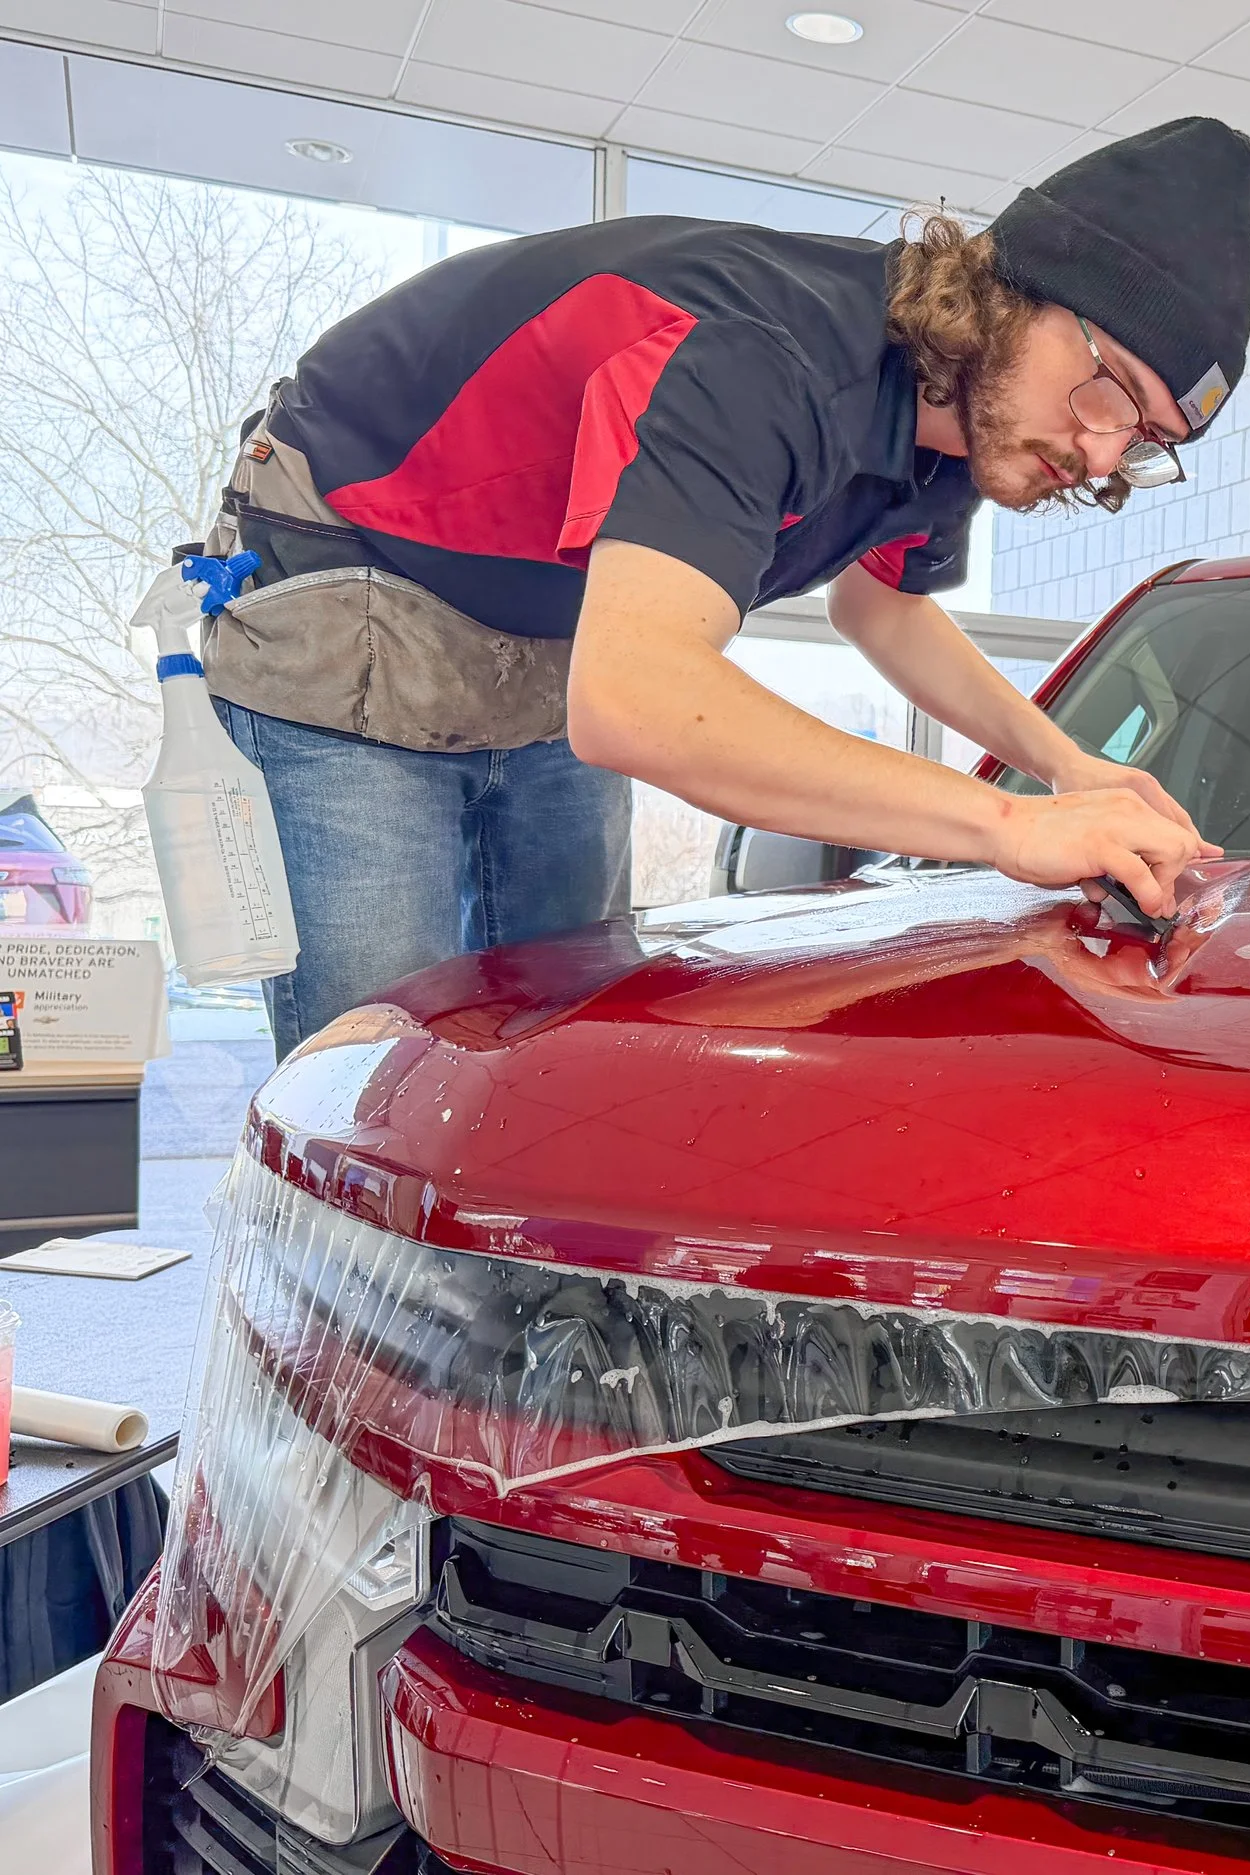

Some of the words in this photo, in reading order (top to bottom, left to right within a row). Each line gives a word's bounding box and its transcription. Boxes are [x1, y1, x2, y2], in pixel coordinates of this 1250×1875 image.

[7, 944, 51, 956] PRIDE,
[55, 945, 140, 958] DEDICATION,
[0, 956, 15, 966] ND
[20, 956, 83, 968] BRAVERY
[88, 958, 115, 969] ARE
[7, 968, 92, 980] UNMATCHED
[34, 991, 82, 1003] Military
